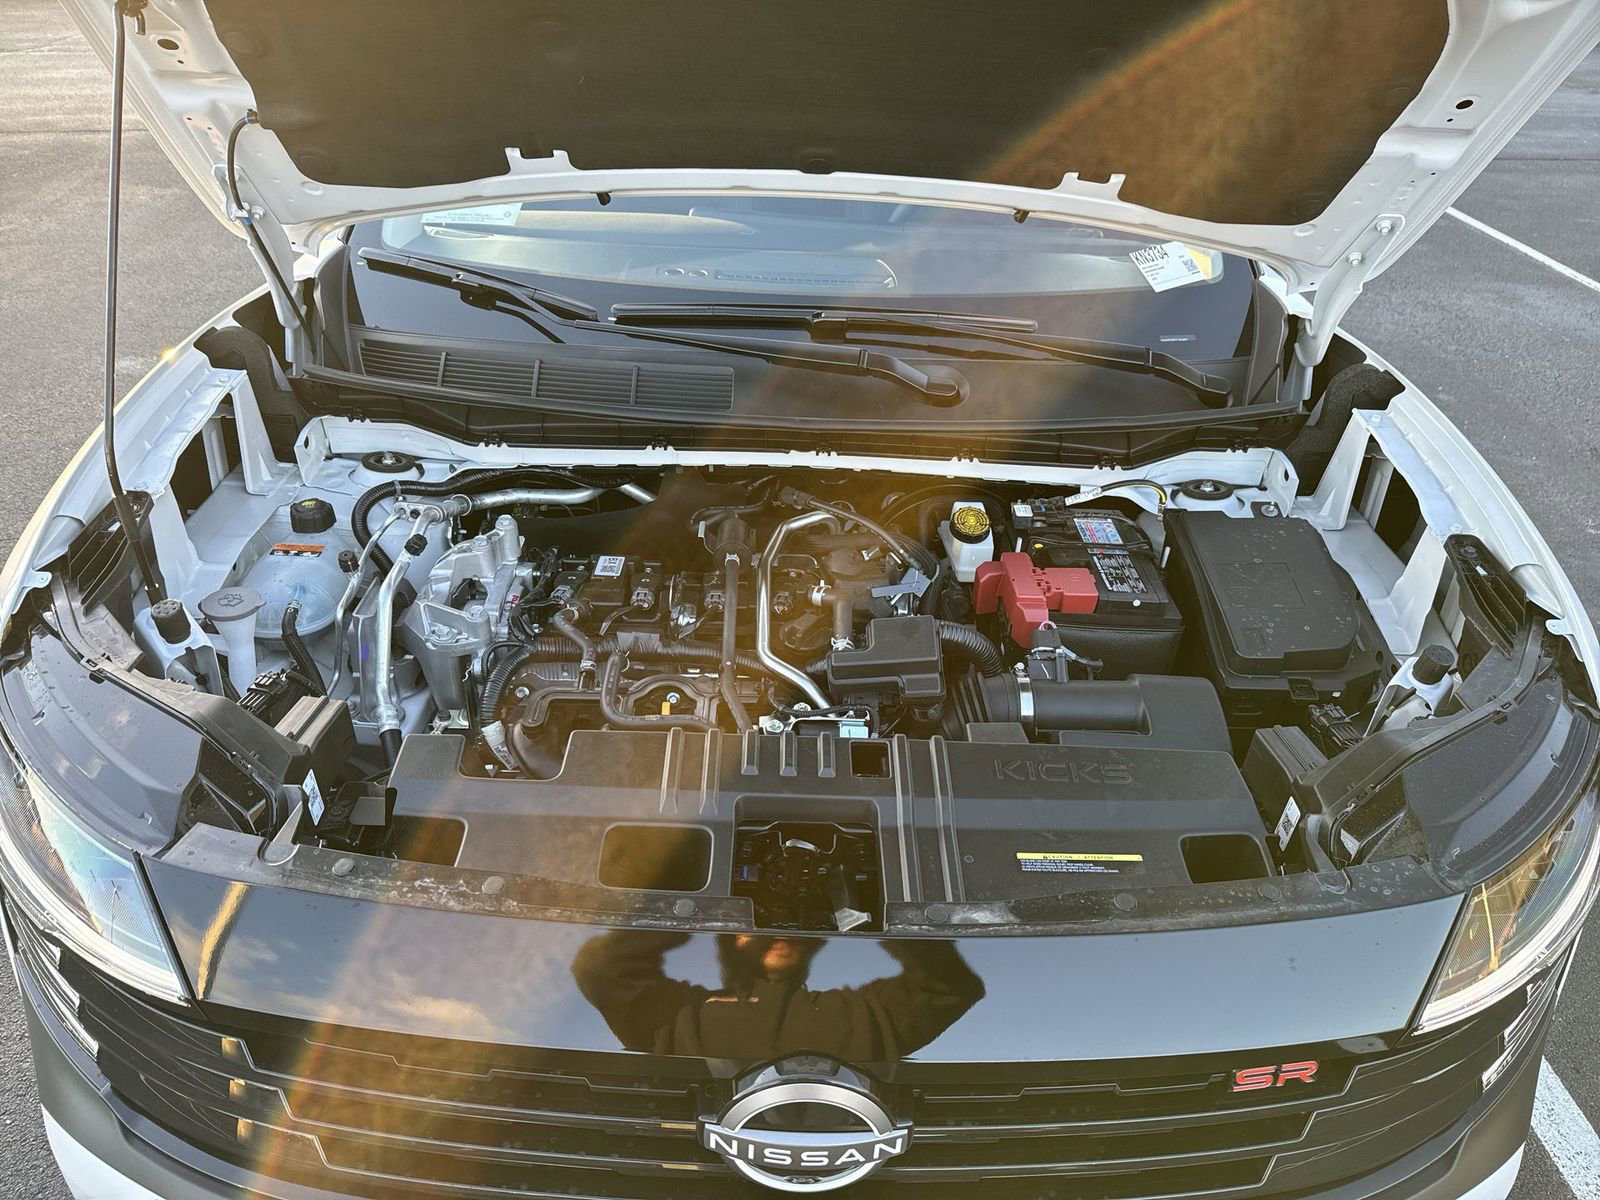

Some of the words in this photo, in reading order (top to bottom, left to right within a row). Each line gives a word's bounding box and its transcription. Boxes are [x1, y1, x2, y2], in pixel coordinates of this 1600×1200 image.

[1133, 245, 1169, 265] KN3734
[994, 759, 1132, 785] KICKS
[1232, 1060, 1319, 1092] SR
[709, 1133, 903, 1166] NISSAN
